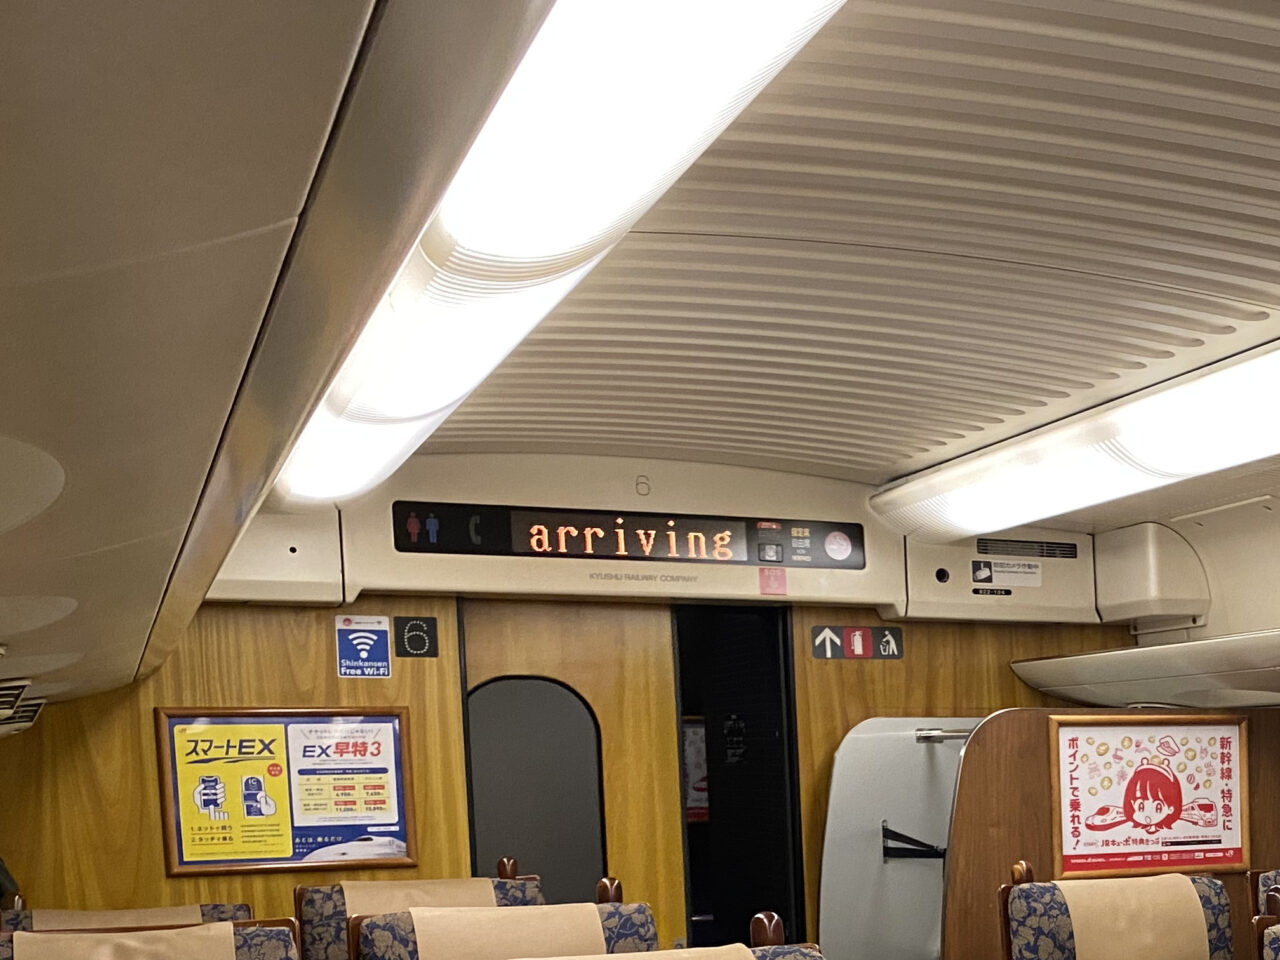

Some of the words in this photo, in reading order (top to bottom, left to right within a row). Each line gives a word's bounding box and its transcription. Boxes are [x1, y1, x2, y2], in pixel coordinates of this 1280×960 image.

[635, 475, 651, 496] 6
[529, 517, 733, 561] arriving
[589, 573, 622, 581] KYUSHU
[624, 573, 658, 582] RAILWAY
[660, 575, 699, 583] COMPANY
[404, 620, 429, 654] 6
[340, 659, 388, 668] Shinkansen
[340, 667, 362, 676] Free
[364, 667, 388, 676] Wi-Fi
[185, 738, 277, 756] スマートEX
[302, 740, 382, 758] EX早特3
[1219, 736, 1233, 831] 新幹線・特急に
